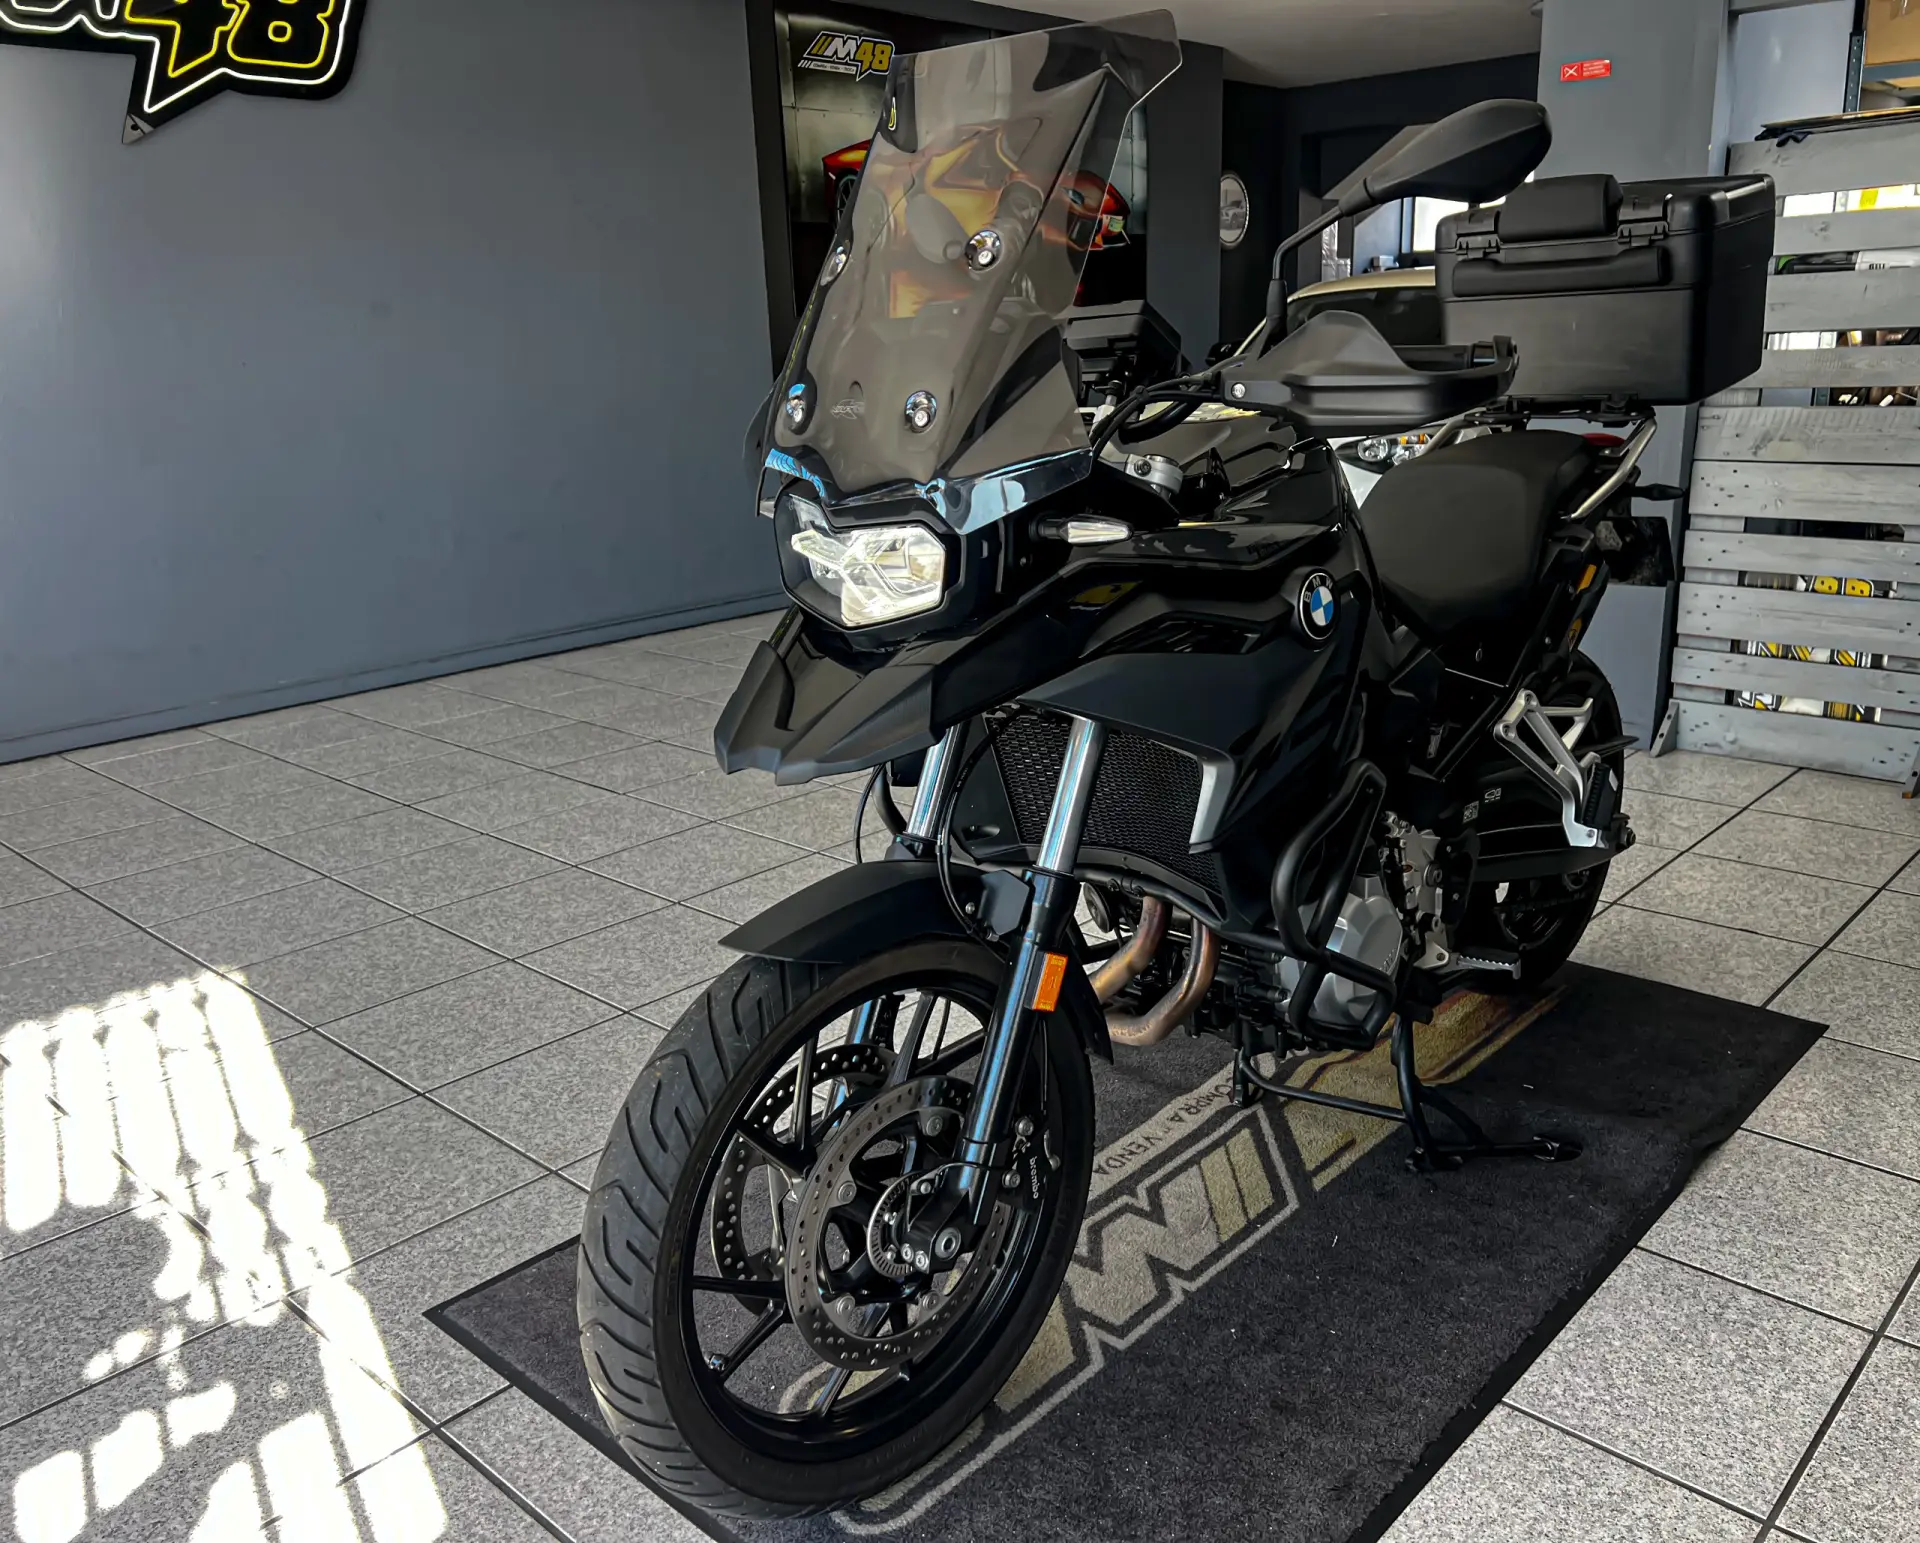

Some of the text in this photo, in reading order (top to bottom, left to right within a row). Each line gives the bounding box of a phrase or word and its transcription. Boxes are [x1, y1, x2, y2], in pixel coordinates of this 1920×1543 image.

[10, 0, 338, 78] 48
[1303, 575, 1333, 604] BMW
[1092, 1134, 1163, 1176] VENDA
[1029, 1155, 1040, 1199] brembo
